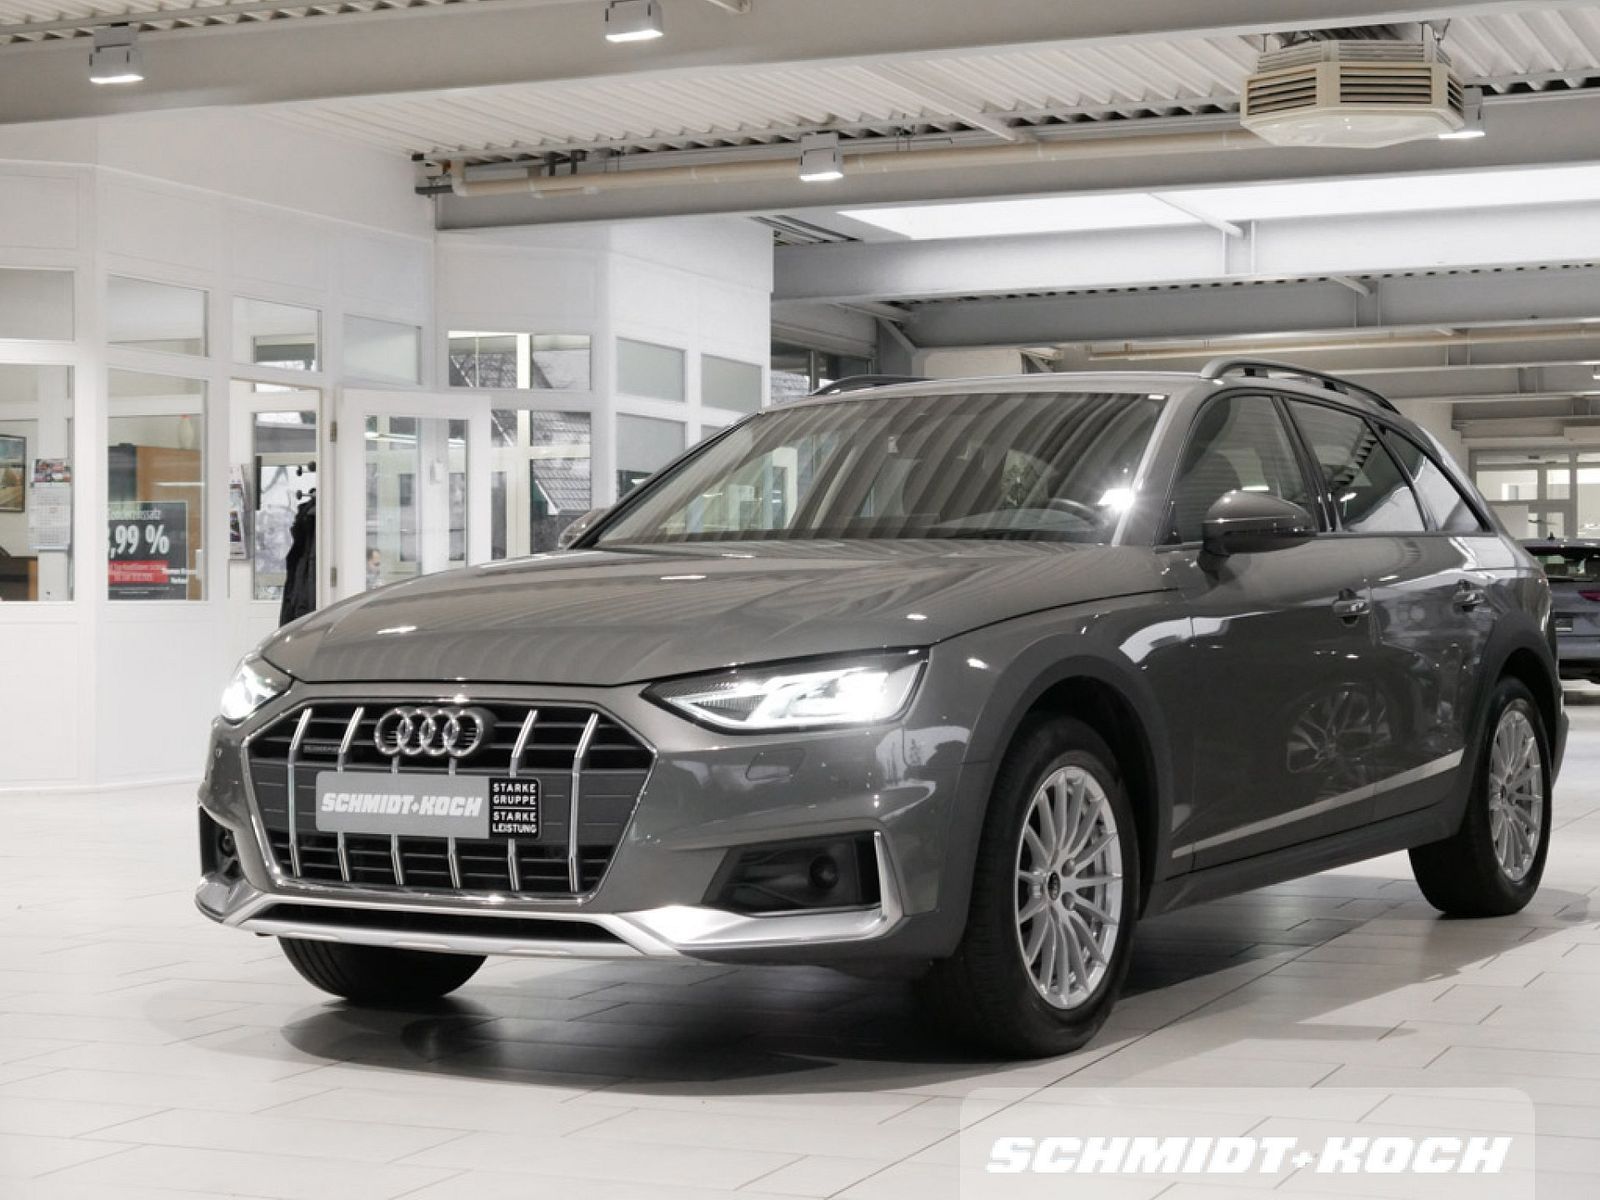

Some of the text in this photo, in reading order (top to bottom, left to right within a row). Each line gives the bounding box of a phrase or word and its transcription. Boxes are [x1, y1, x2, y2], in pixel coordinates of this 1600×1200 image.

[107, 524, 170, 559] ,99 %
[493, 782, 536, 793] STARKE
[493, 794, 536, 805] GRUPPE
[493, 811, 536, 822] STARKE
[492, 822, 537, 834] LEISTUNG
